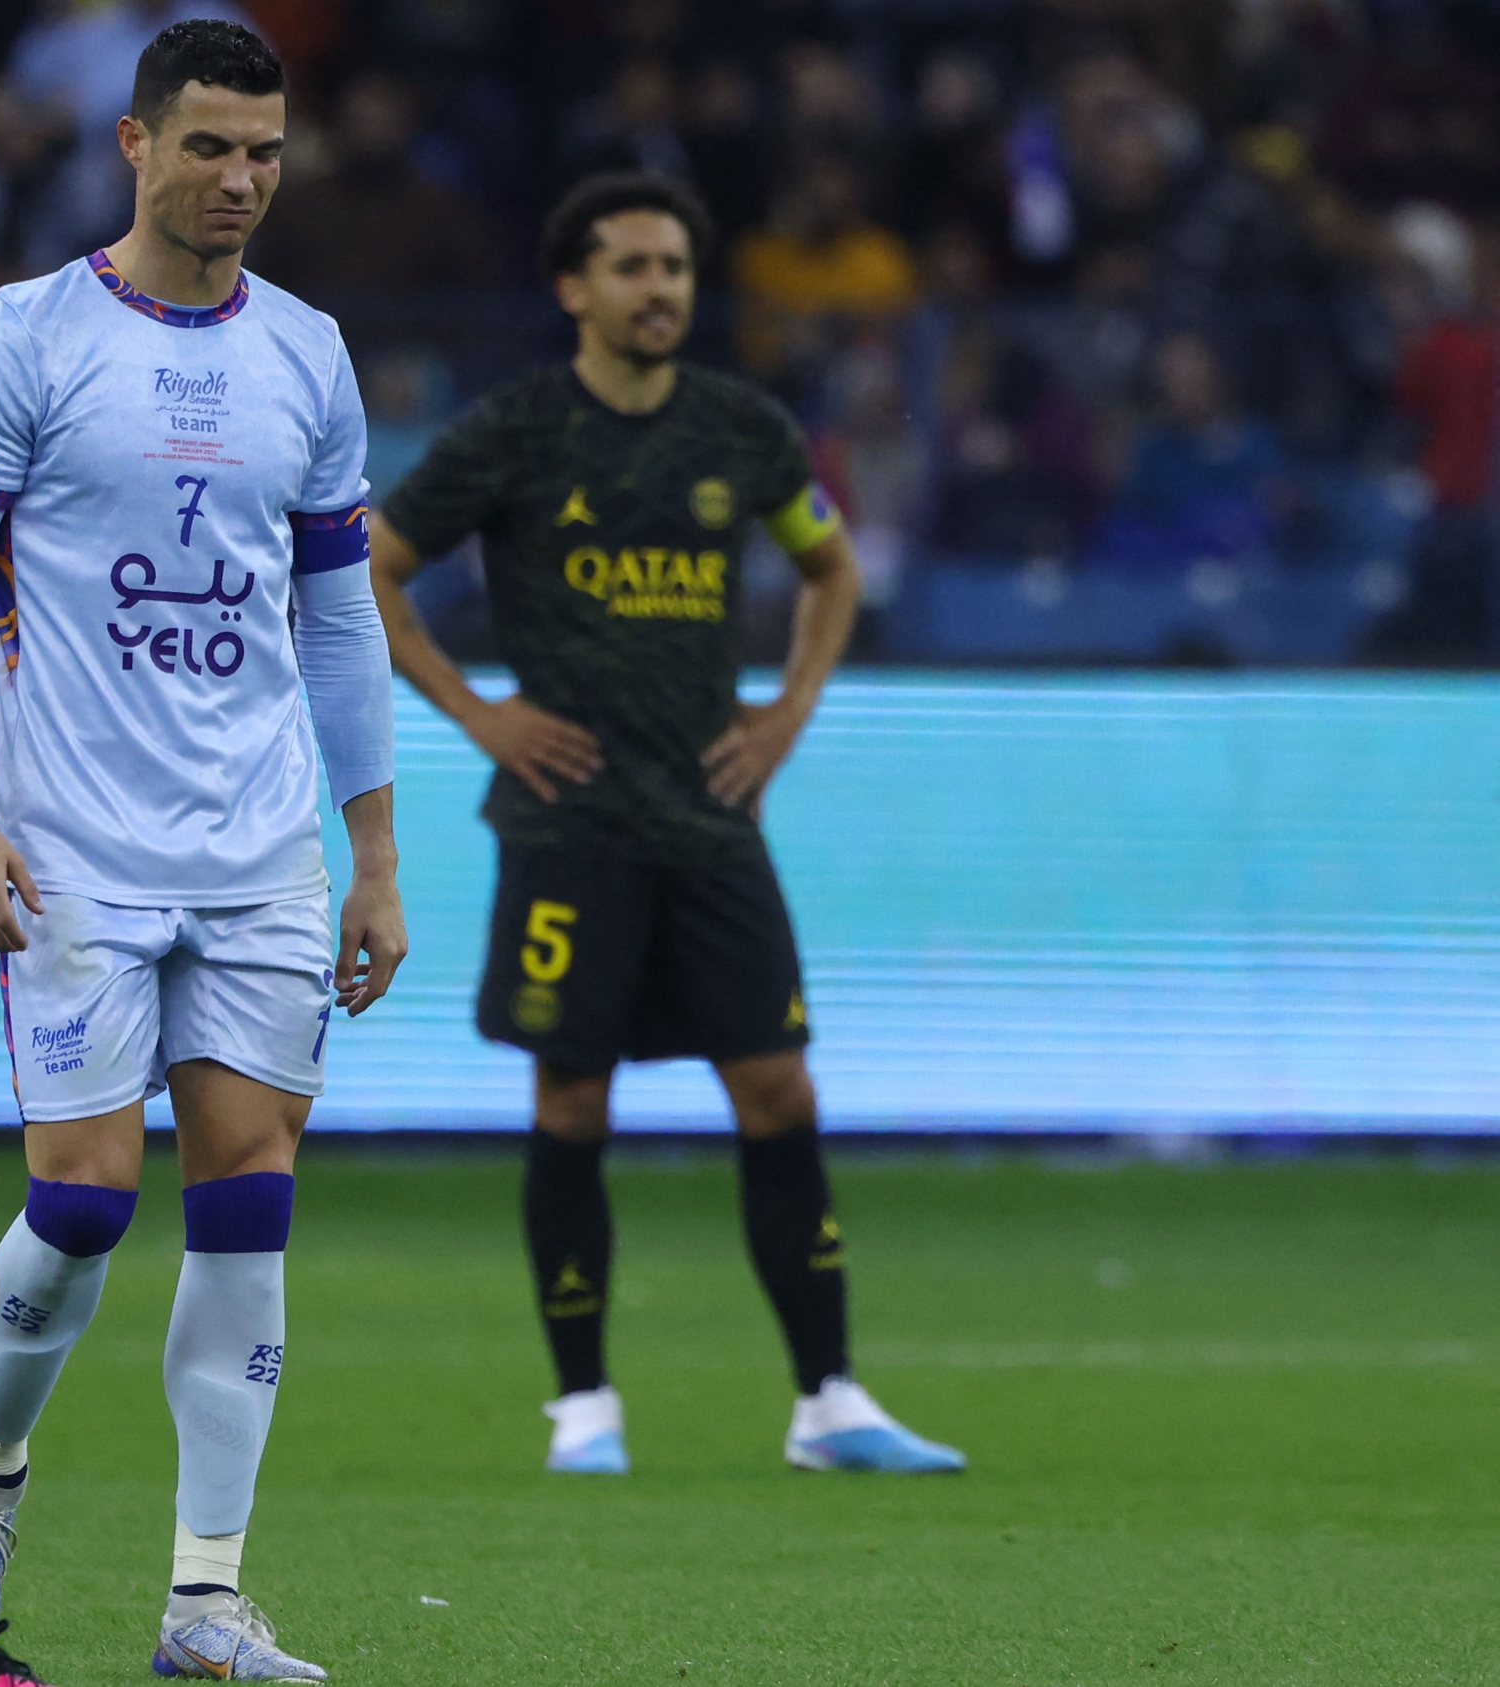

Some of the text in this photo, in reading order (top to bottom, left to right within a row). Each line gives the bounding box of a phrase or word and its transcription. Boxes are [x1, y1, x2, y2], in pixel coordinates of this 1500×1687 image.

[154, 368, 228, 402] Riyadh
[171, 414, 218, 433] team
[174, 474, 208, 547] 7
[563, 545, 727, 600] QATAR
[519, 899, 578, 983] 5
[32, 1016, 86, 1053] Riyadh
[45, 1058, 84, 1075] team
[249, 1344, 283, 1365] RS
[245, 1364, 279, 1386] 22
